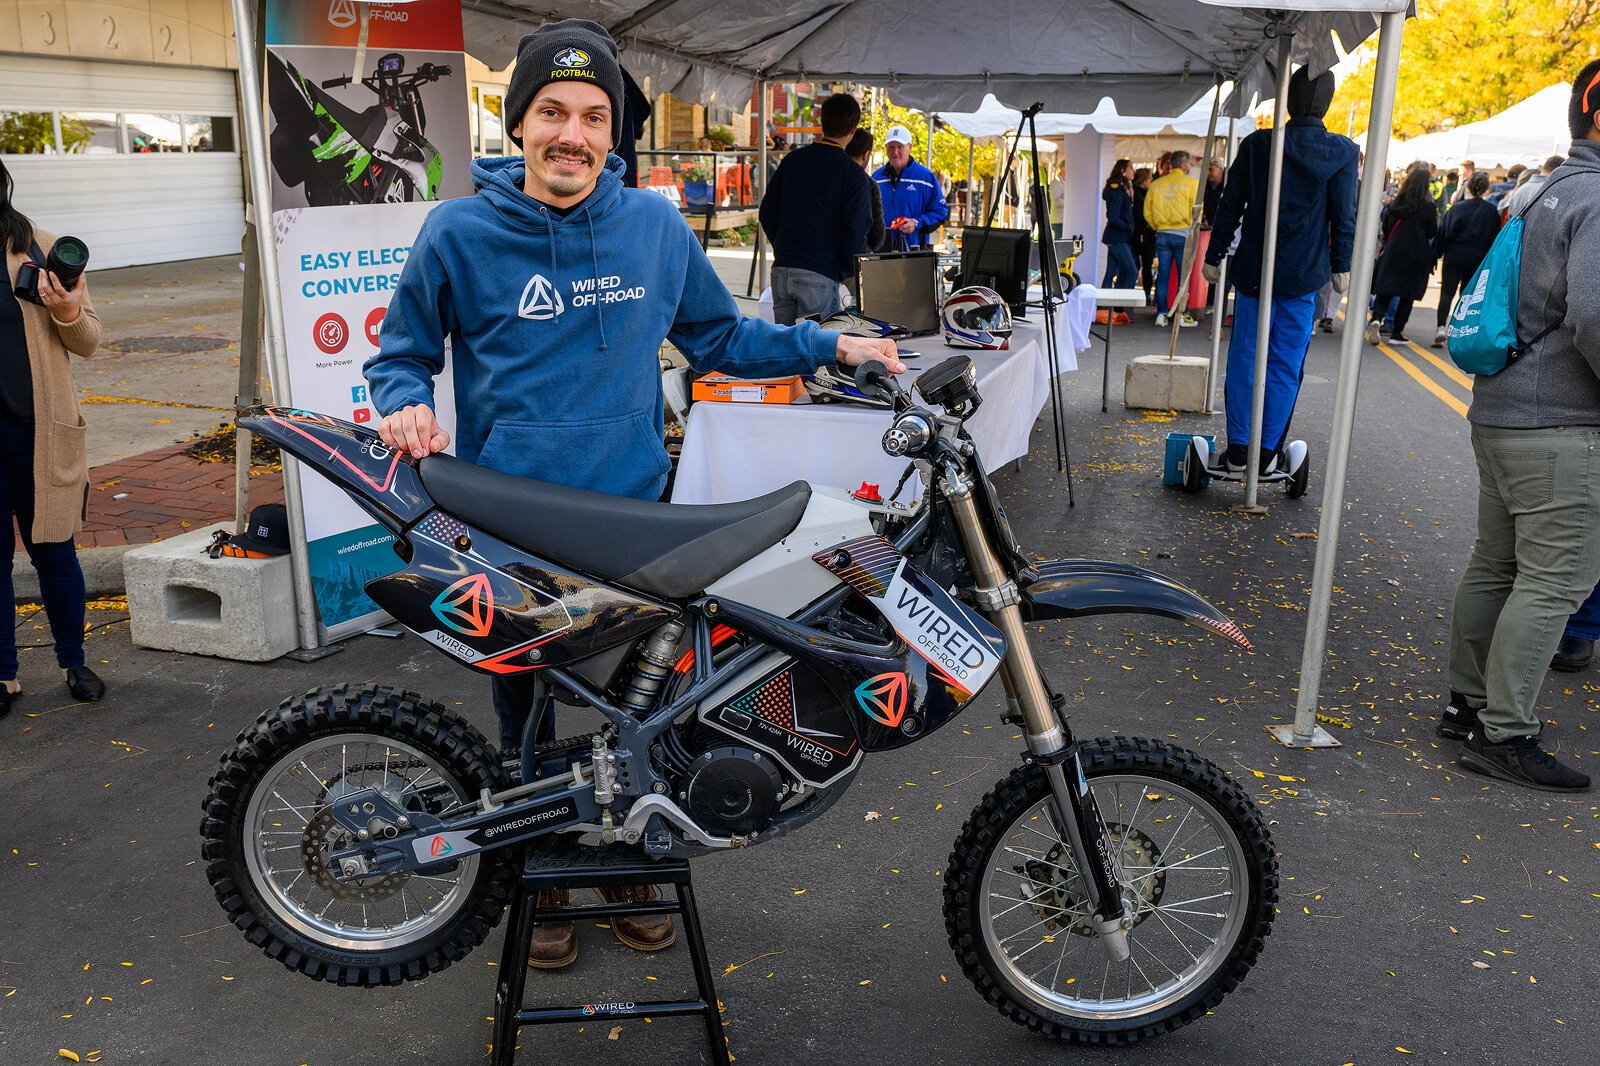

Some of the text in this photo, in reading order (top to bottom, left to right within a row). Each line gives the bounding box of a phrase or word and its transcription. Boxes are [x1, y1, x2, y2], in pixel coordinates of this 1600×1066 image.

[368, 10, 409, 22] FF-ROAD
[40, 11, 174, 56] 3 2 2
[551, 69, 596, 79] FOOTBALL
[301, 252, 352, 271] EASY
[571, 275, 621, 293] WIRED
[572, 286, 646, 308] OFF-ROAD
[333, 359, 353, 367] Power
[337, 535, 392, 555] wiredoffroad.com
[896, 587, 985, 670] WIRED
[436, 631, 475, 658] WIRED
[917, 634, 969, 680] OFF-ROAD
[786, 734, 834, 762] WIRED
[800, 752, 829, 768] OFF-ROAD
[484, 806, 570, 838] @WIREDOFFROAD
[1096, 839, 1116, 888] OFF-ROAD
[593, 1002, 635, 1011] WIRED
